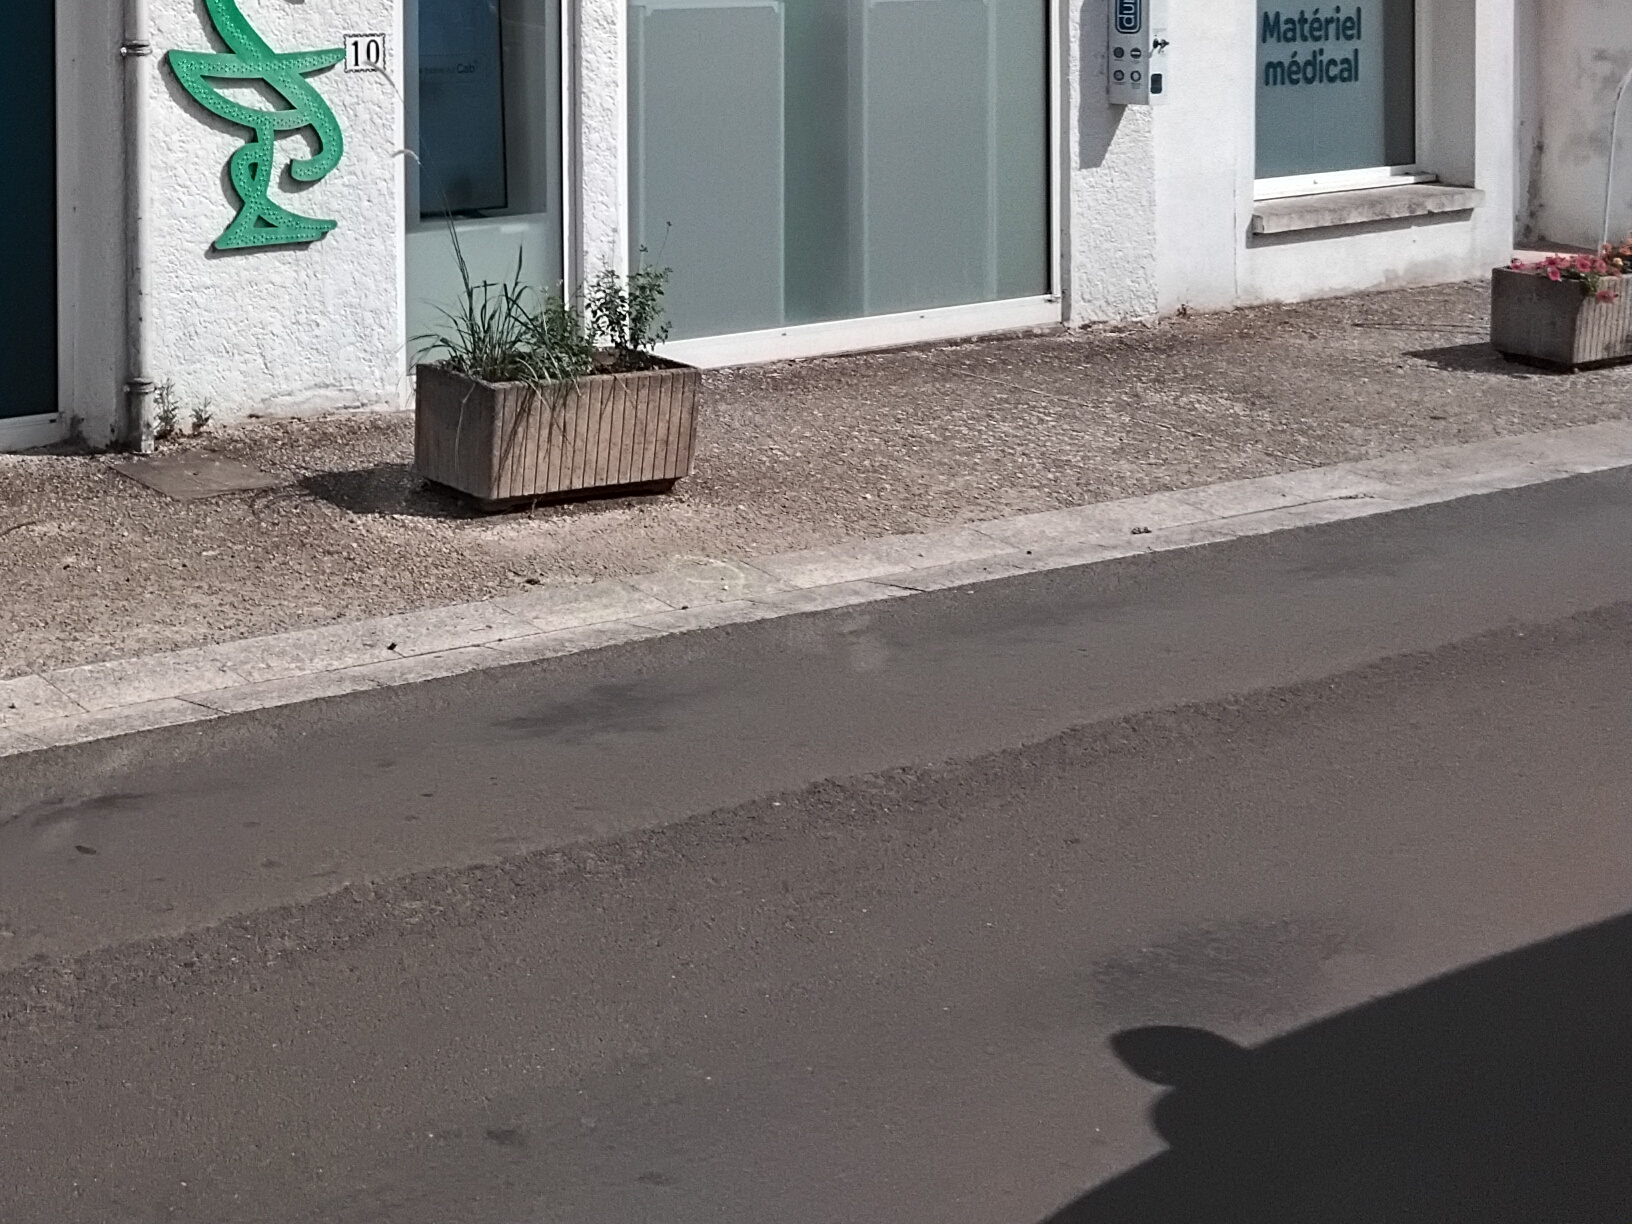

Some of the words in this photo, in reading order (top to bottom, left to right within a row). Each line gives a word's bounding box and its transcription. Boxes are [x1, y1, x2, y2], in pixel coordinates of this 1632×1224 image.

[1261, 5, 1362, 44] Matériel
[350, 39, 380, 67] 10
[1263, 48, 1360, 87] médical
